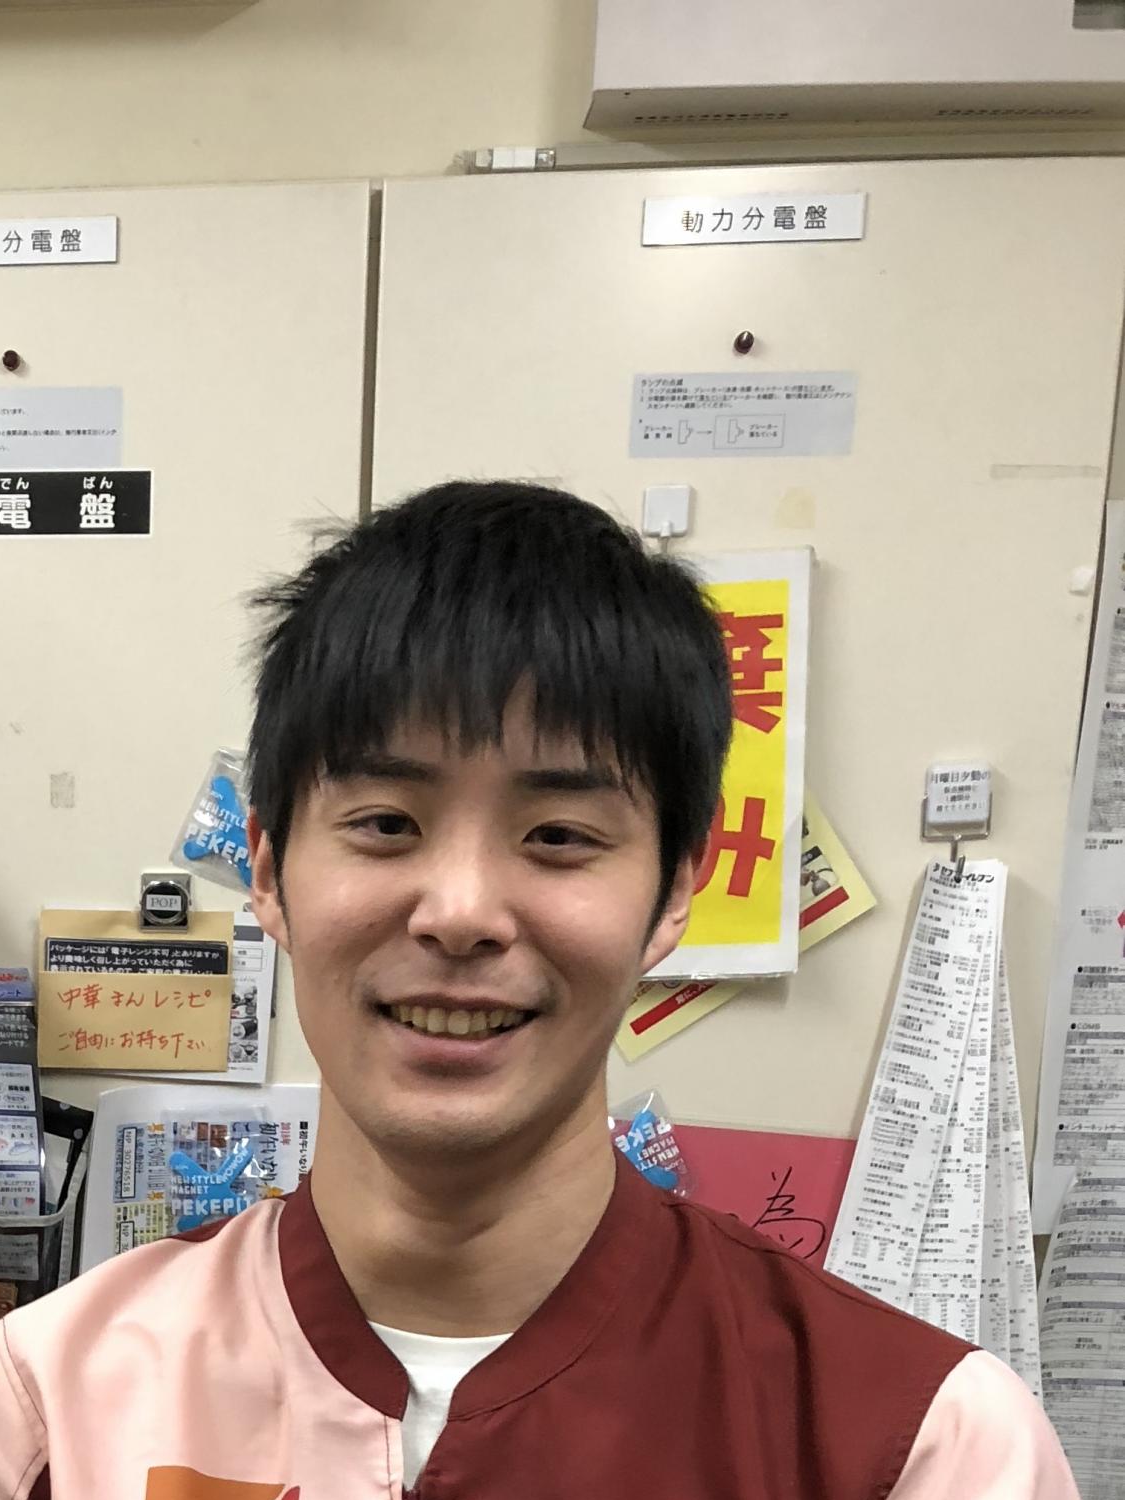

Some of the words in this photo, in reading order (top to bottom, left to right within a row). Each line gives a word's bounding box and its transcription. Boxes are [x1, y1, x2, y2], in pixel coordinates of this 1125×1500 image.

[681, 204, 828, 234] 動力分電盤
[82, 476, 113, 489] ばん
[150, 897, 178, 908] POP
[171, 1195, 251, 1216] PEKEPIT
